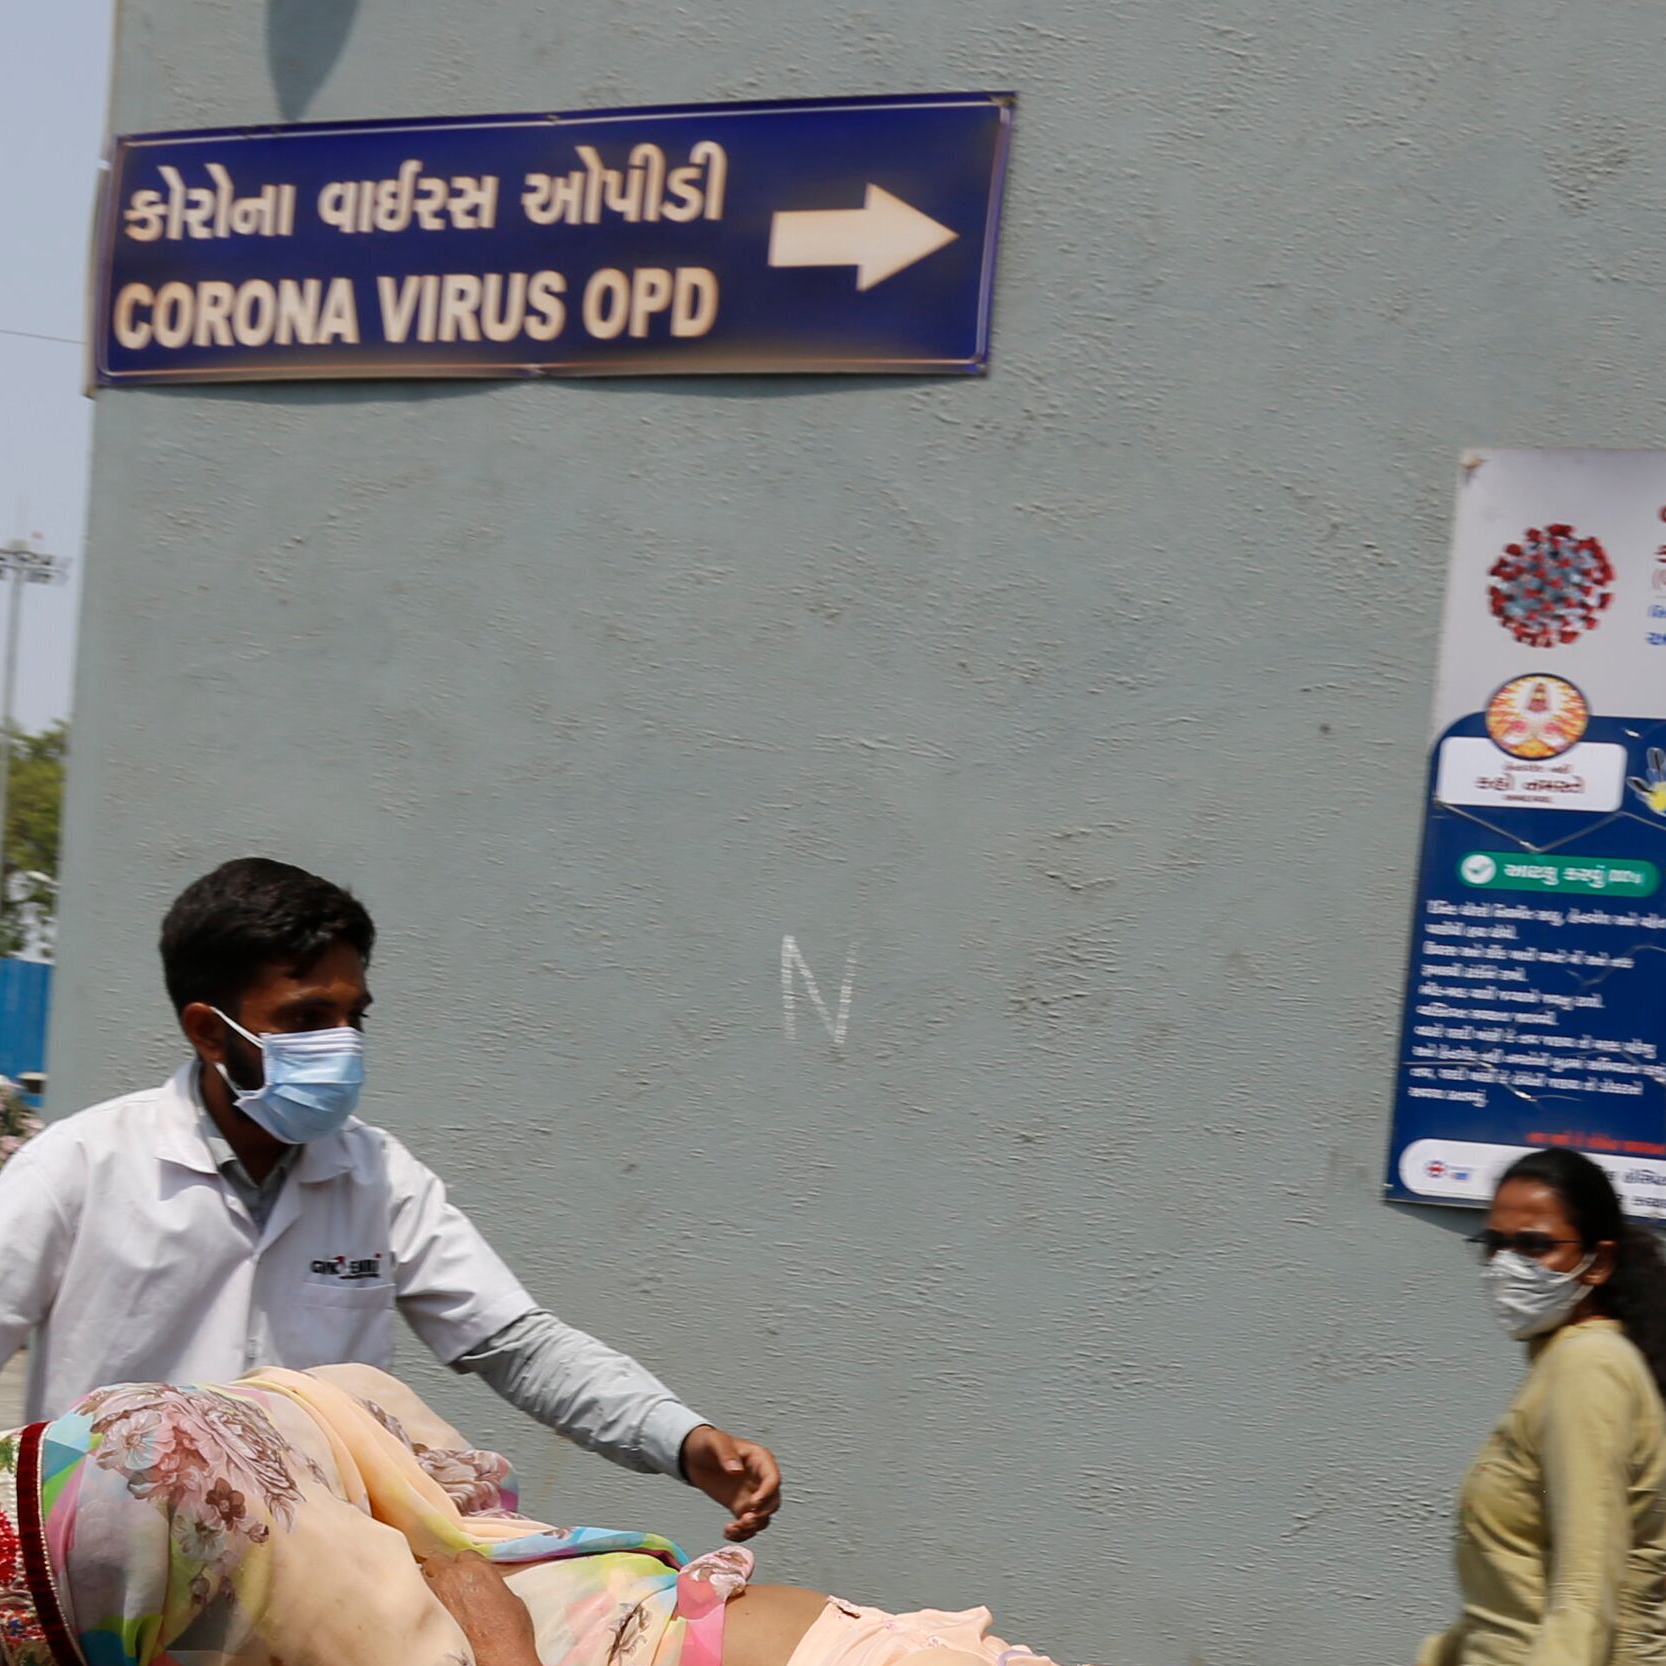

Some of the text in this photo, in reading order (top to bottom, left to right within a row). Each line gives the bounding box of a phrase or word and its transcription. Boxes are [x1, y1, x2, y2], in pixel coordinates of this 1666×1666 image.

[125, 141, 726, 241] કોરોના વાઈરસ ઓપીડી
[114, 267, 719, 349] CORONA VIRUS OPD
